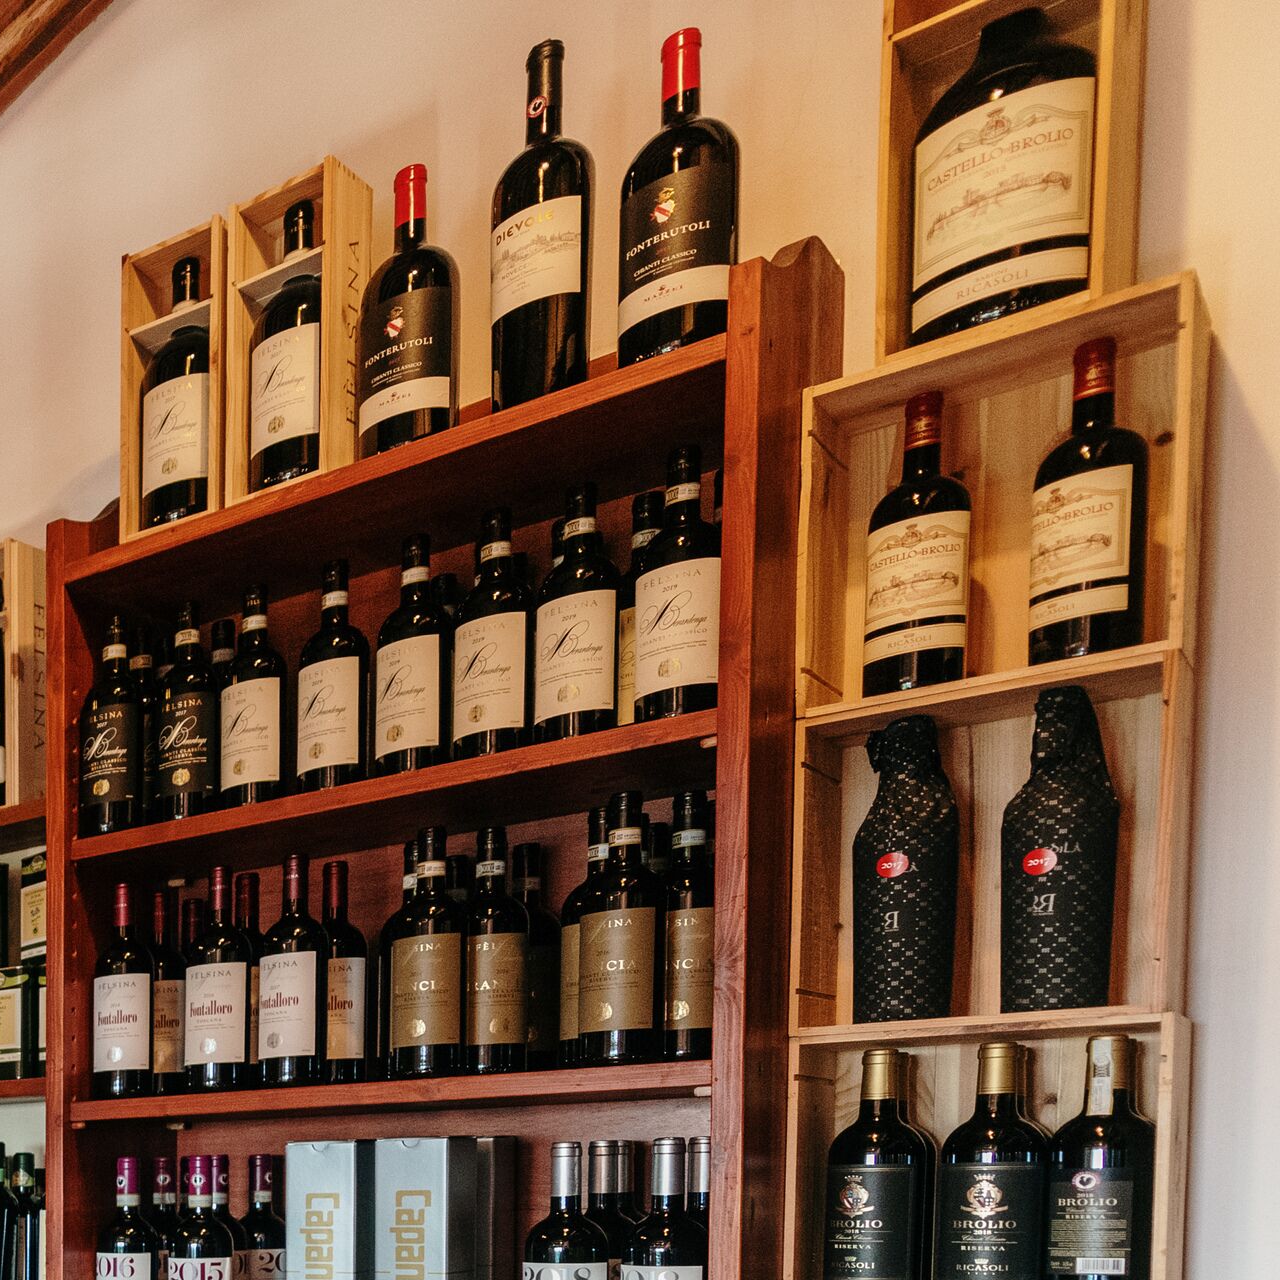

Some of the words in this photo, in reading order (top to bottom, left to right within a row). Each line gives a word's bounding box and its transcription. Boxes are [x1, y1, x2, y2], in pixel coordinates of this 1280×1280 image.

[1009, 128, 1075, 153] BROLIO
[496, 208, 554, 246] DIEVOLE
[626, 219, 711, 261] FONTERUTOLI
[659, 248, 698, 267] CLASSICO
[956, 269, 1029, 300] RICASOLI
[364, 336, 433, 369] FONTERUTOLI
[1063, 501, 1115, 520] BROLIO
[920, 542, 961, 556] BROLIO
[886, 634, 933, 649] RICASOLI
[96, 1009, 138, 1027] Fontalloro
[190, 999, 233, 1018] Fontalloro
[1058, 1198, 1118, 1206] BROLIO
[953, 1219, 1017, 1229] BROLIO
[955, 1263, 1009, 1272] RICASOLI
